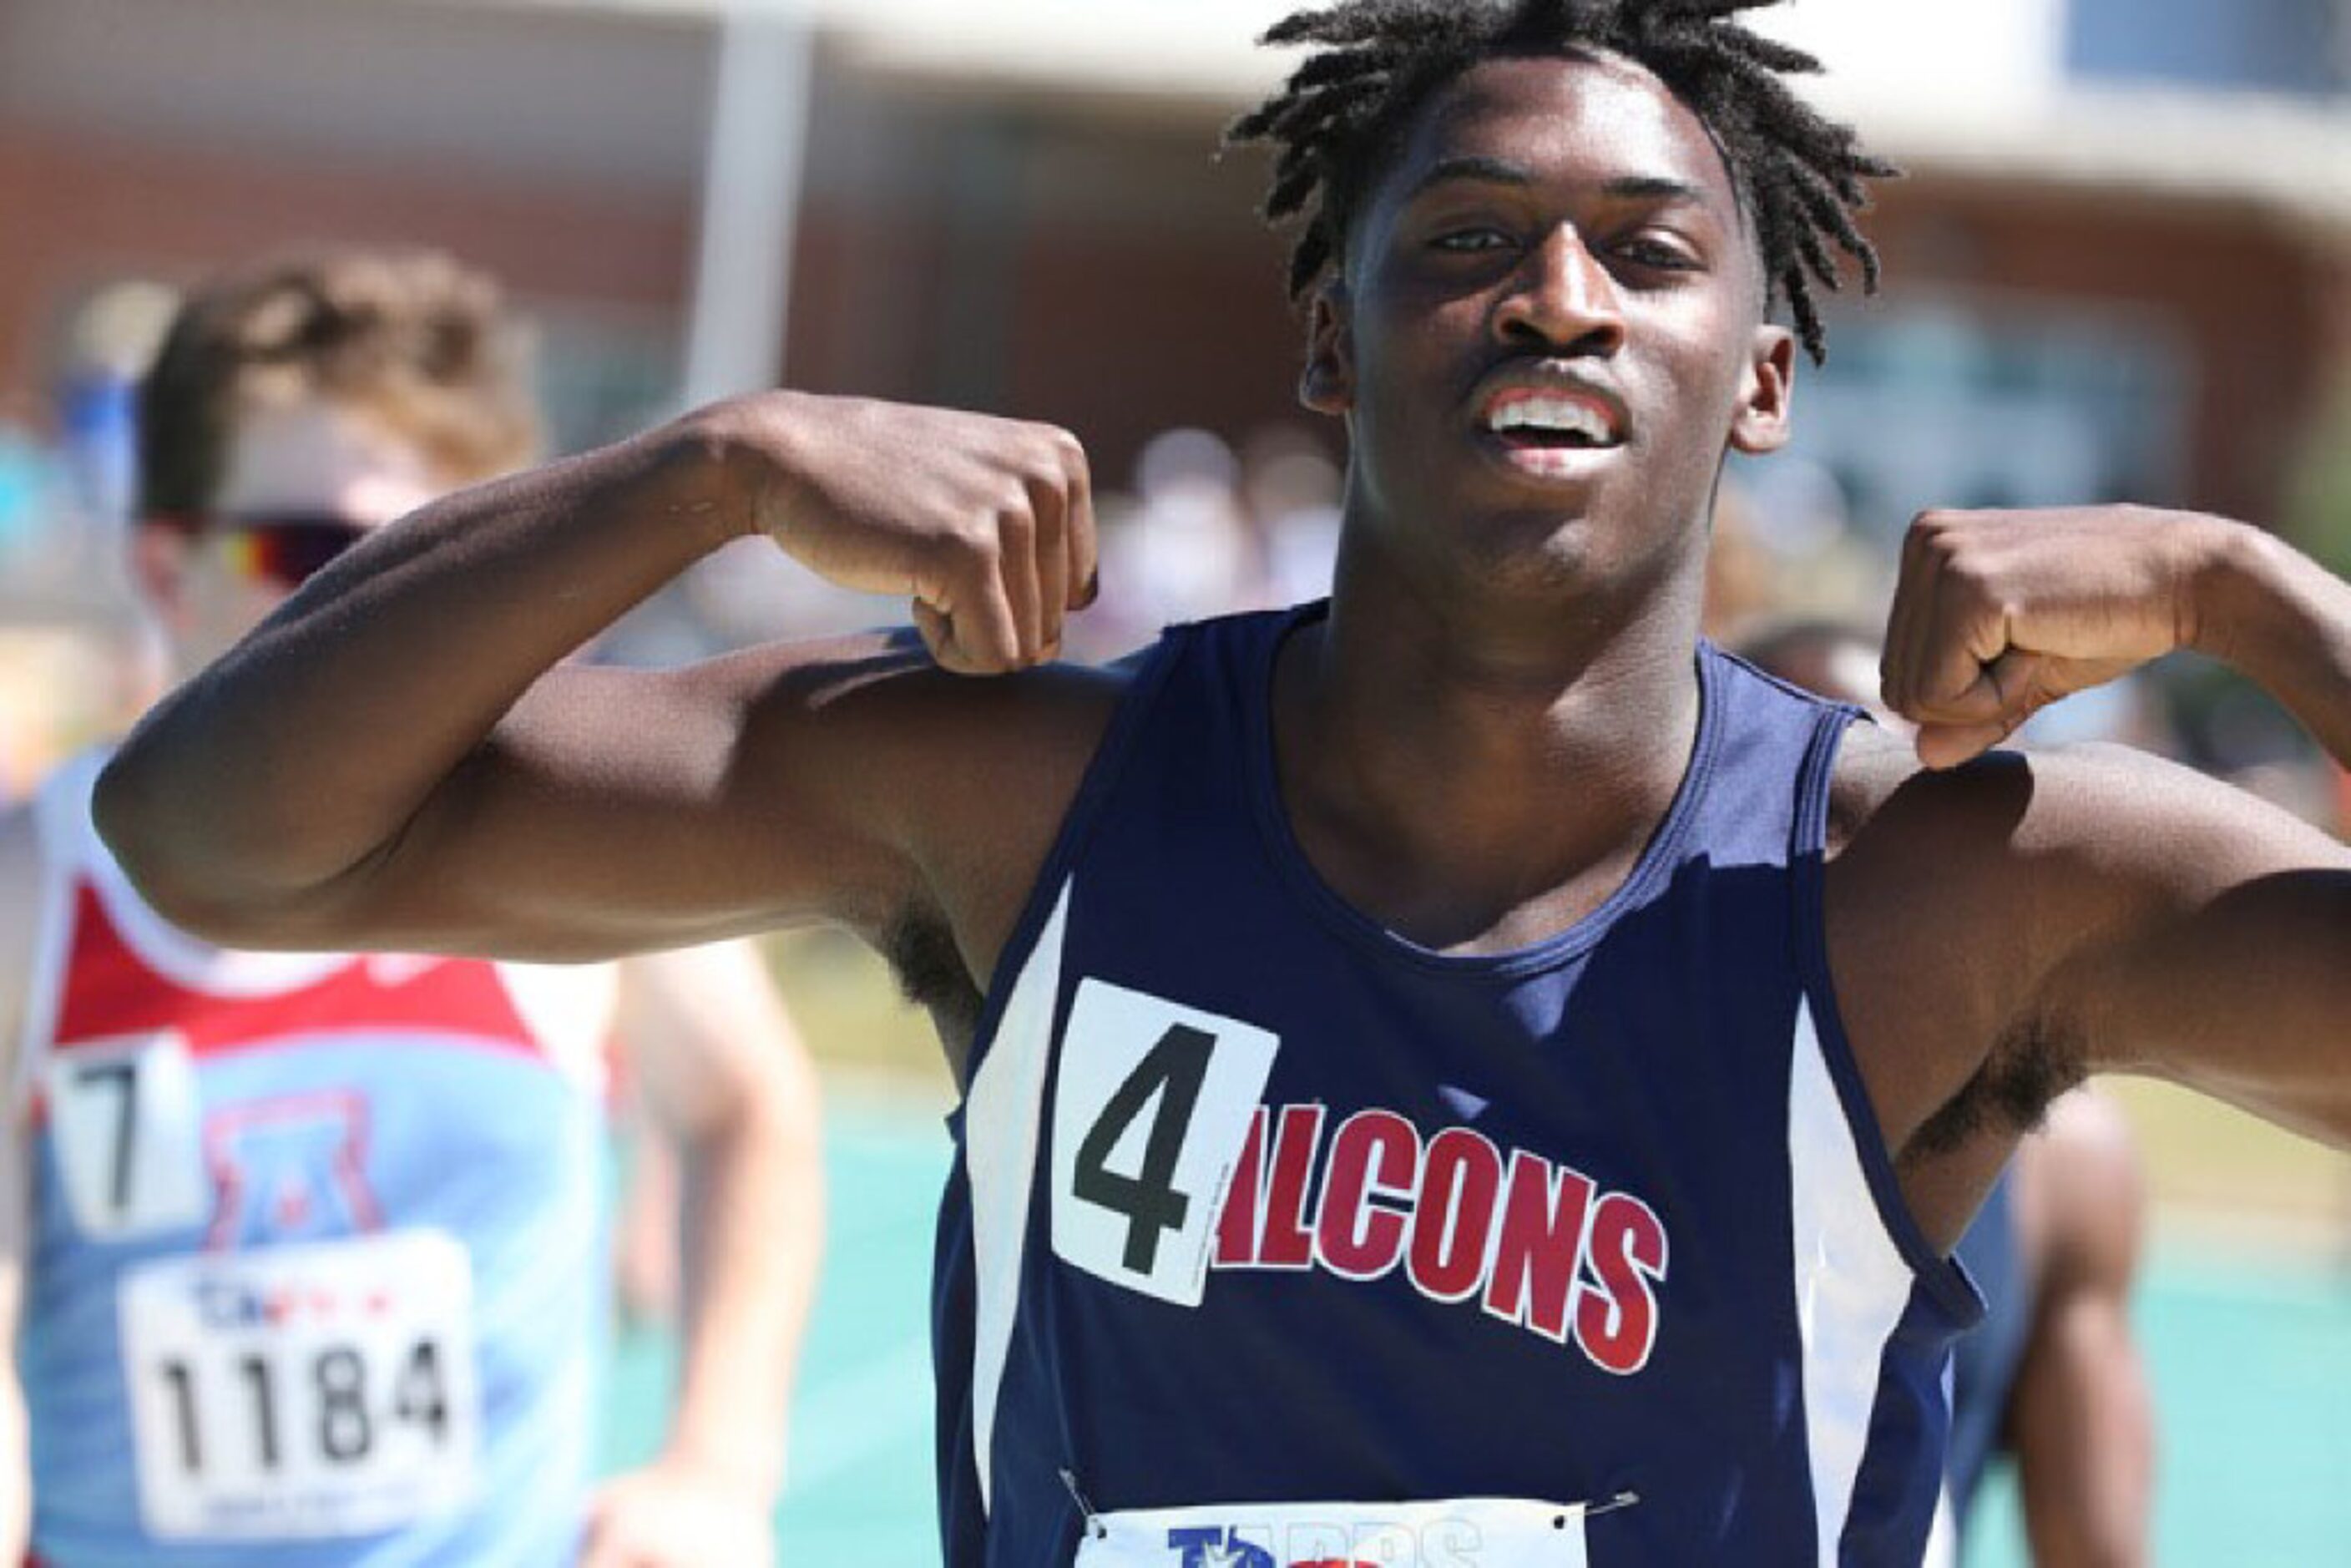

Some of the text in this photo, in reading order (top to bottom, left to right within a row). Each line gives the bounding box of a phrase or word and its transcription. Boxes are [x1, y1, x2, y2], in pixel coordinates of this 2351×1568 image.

[78, 1062, 137, 1209] 7
[1073, 1023, 1218, 1276] 4
[1211, 1105, 1668, 1376] ALCONS
[159, 1336, 451, 1474] 1184
